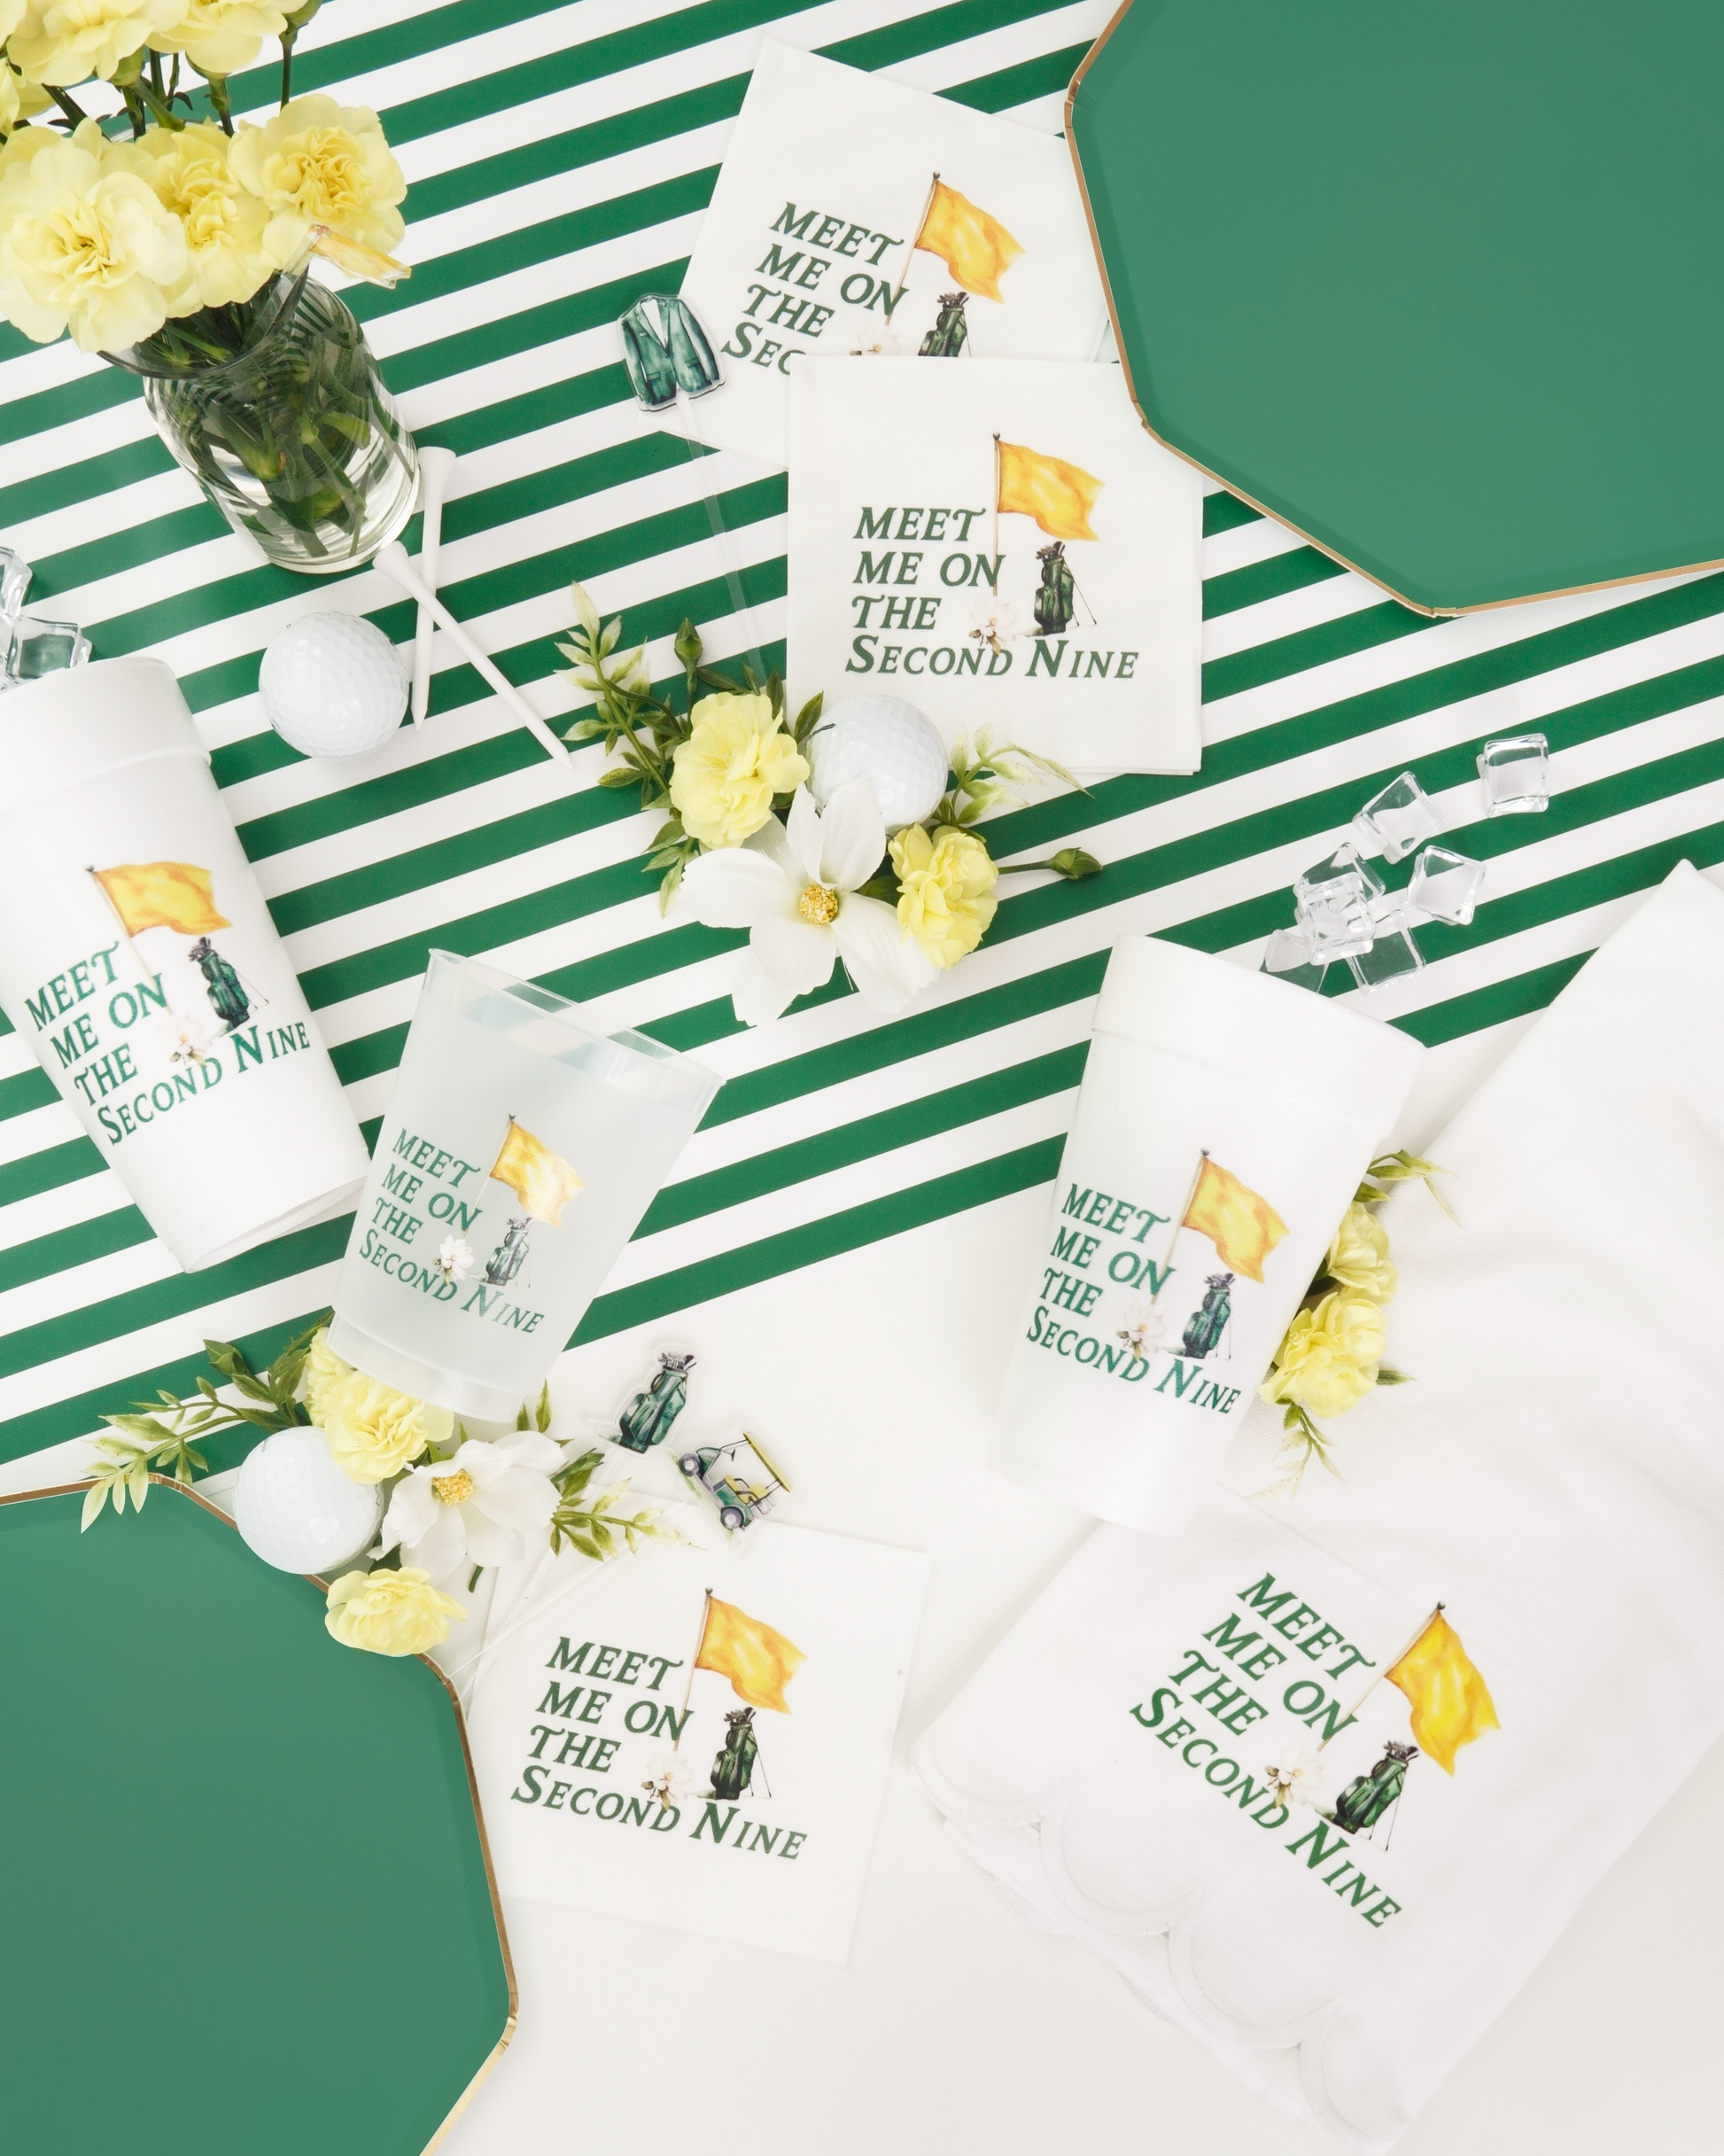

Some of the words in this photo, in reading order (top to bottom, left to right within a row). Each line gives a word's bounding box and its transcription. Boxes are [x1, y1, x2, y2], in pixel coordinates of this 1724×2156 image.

[769, 202, 904, 267] MEET
[742, 284, 835, 338] THE
[755, 244, 831, 290] ME
[840, 273, 909, 315] ON
[721, 322, 807, 376] SEC
[853, 507, 986, 541] MEET
[852, 551, 923, 585] ME
[939, 553, 1006, 588] ON
[851, 595, 942, 629] THE
[845, 634, 1013, 675] SECOND
[1025, 640, 1138, 679] NINE
[25, 941, 120, 1031] MEET
[50, 1012, 99, 1070] ME
[108, 973, 167, 1029] ON
[74, 1043, 138, 1107] THE
[97, 1057, 222, 1146] SECOND
[229, 1023, 310, 1073] NINE
[392, 1127, 481, 1187] MEET
[371, 1197, 423, 1244] THE
[382, 1164, 423, 1204] ME
[428, 1193, 483, 1231] ON
[1061, 1183, 1171, 1243] MEET
[360, 1228, 458, 1301] SECOND
[461, 1284, 544, 1333] NINE
[1039, 1267, 1104, 1317] THE
[1050, 1226, 1101, 1269] ME
[1108, 1251, 1177, 1296] ON
[1027, 1305, 1150, 1382] SECOND
[1153, 1358, 1241, 1413] NINE
[1236, 1572, 1376, 1681] MEET
[545, 1636, 684, 1691] MEET
[1168, 1650, 1270, 1736] THE
[1201, 1612, 1287, 1681] ME
[1283, 1680, 1359, 1741] ON
[535, 1681, 613, 1724] ME
[625, 1701, 695, 1741] ON
[527, 1725, 622, 1772] THE
[510, 1765, 680, 1832] SECOND
[689, 1802, 808, 1859] NINE
[1129, 1687, 1290, 1829] SECOND
[1285, 1820, 1402, 1928] NINE
